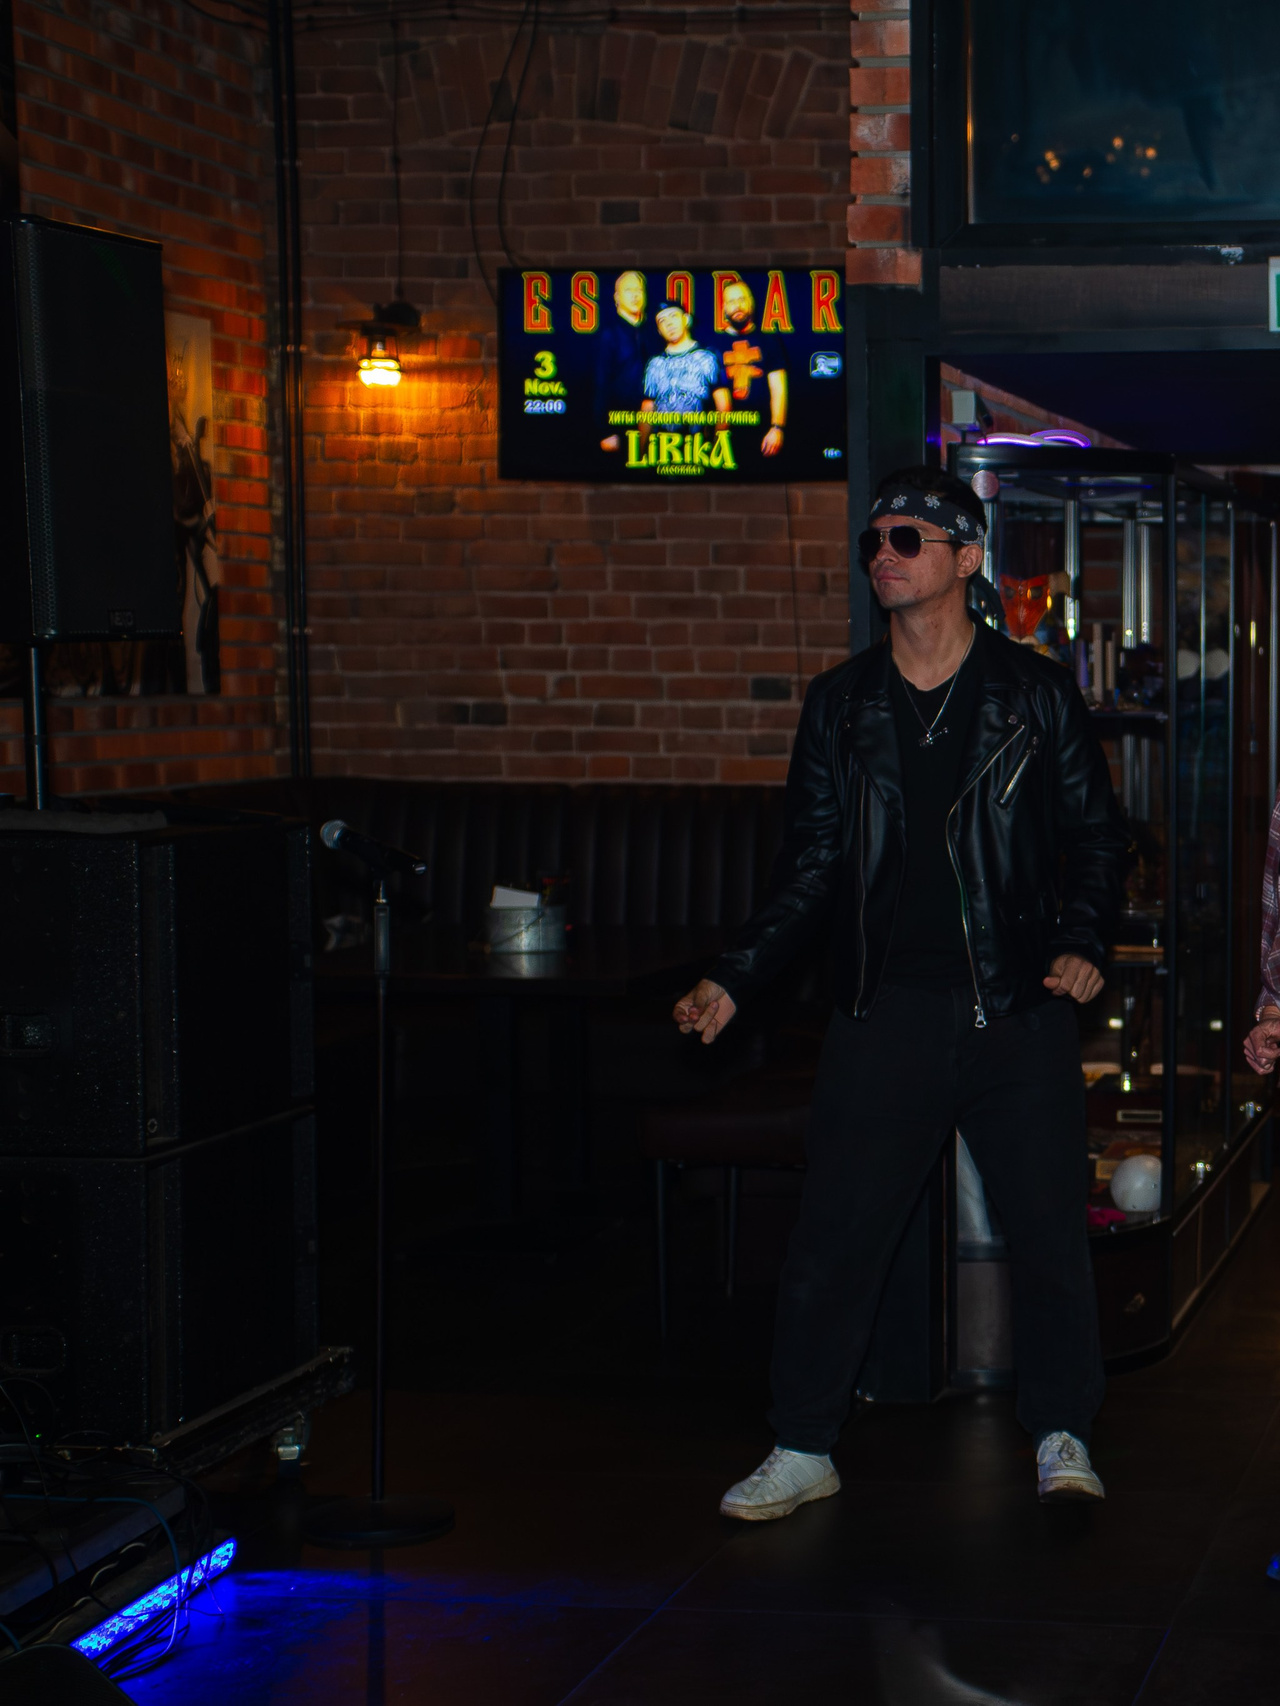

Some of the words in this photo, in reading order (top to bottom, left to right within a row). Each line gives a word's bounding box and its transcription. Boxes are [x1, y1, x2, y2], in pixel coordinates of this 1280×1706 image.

[534, 350, 557, 379] 3
[524, 378, 568, 396] Nov.
[524, 399, 566, 413] 22:00
[608, 411, 635, 425] ХИТЫ
[636, 411, 681, 425] РУССКОГО
[682, 411, 706, 425] РОКА
[707, 411, 719, 425] ОТ
[720, 411, 760, 425] ГРУППЫ
